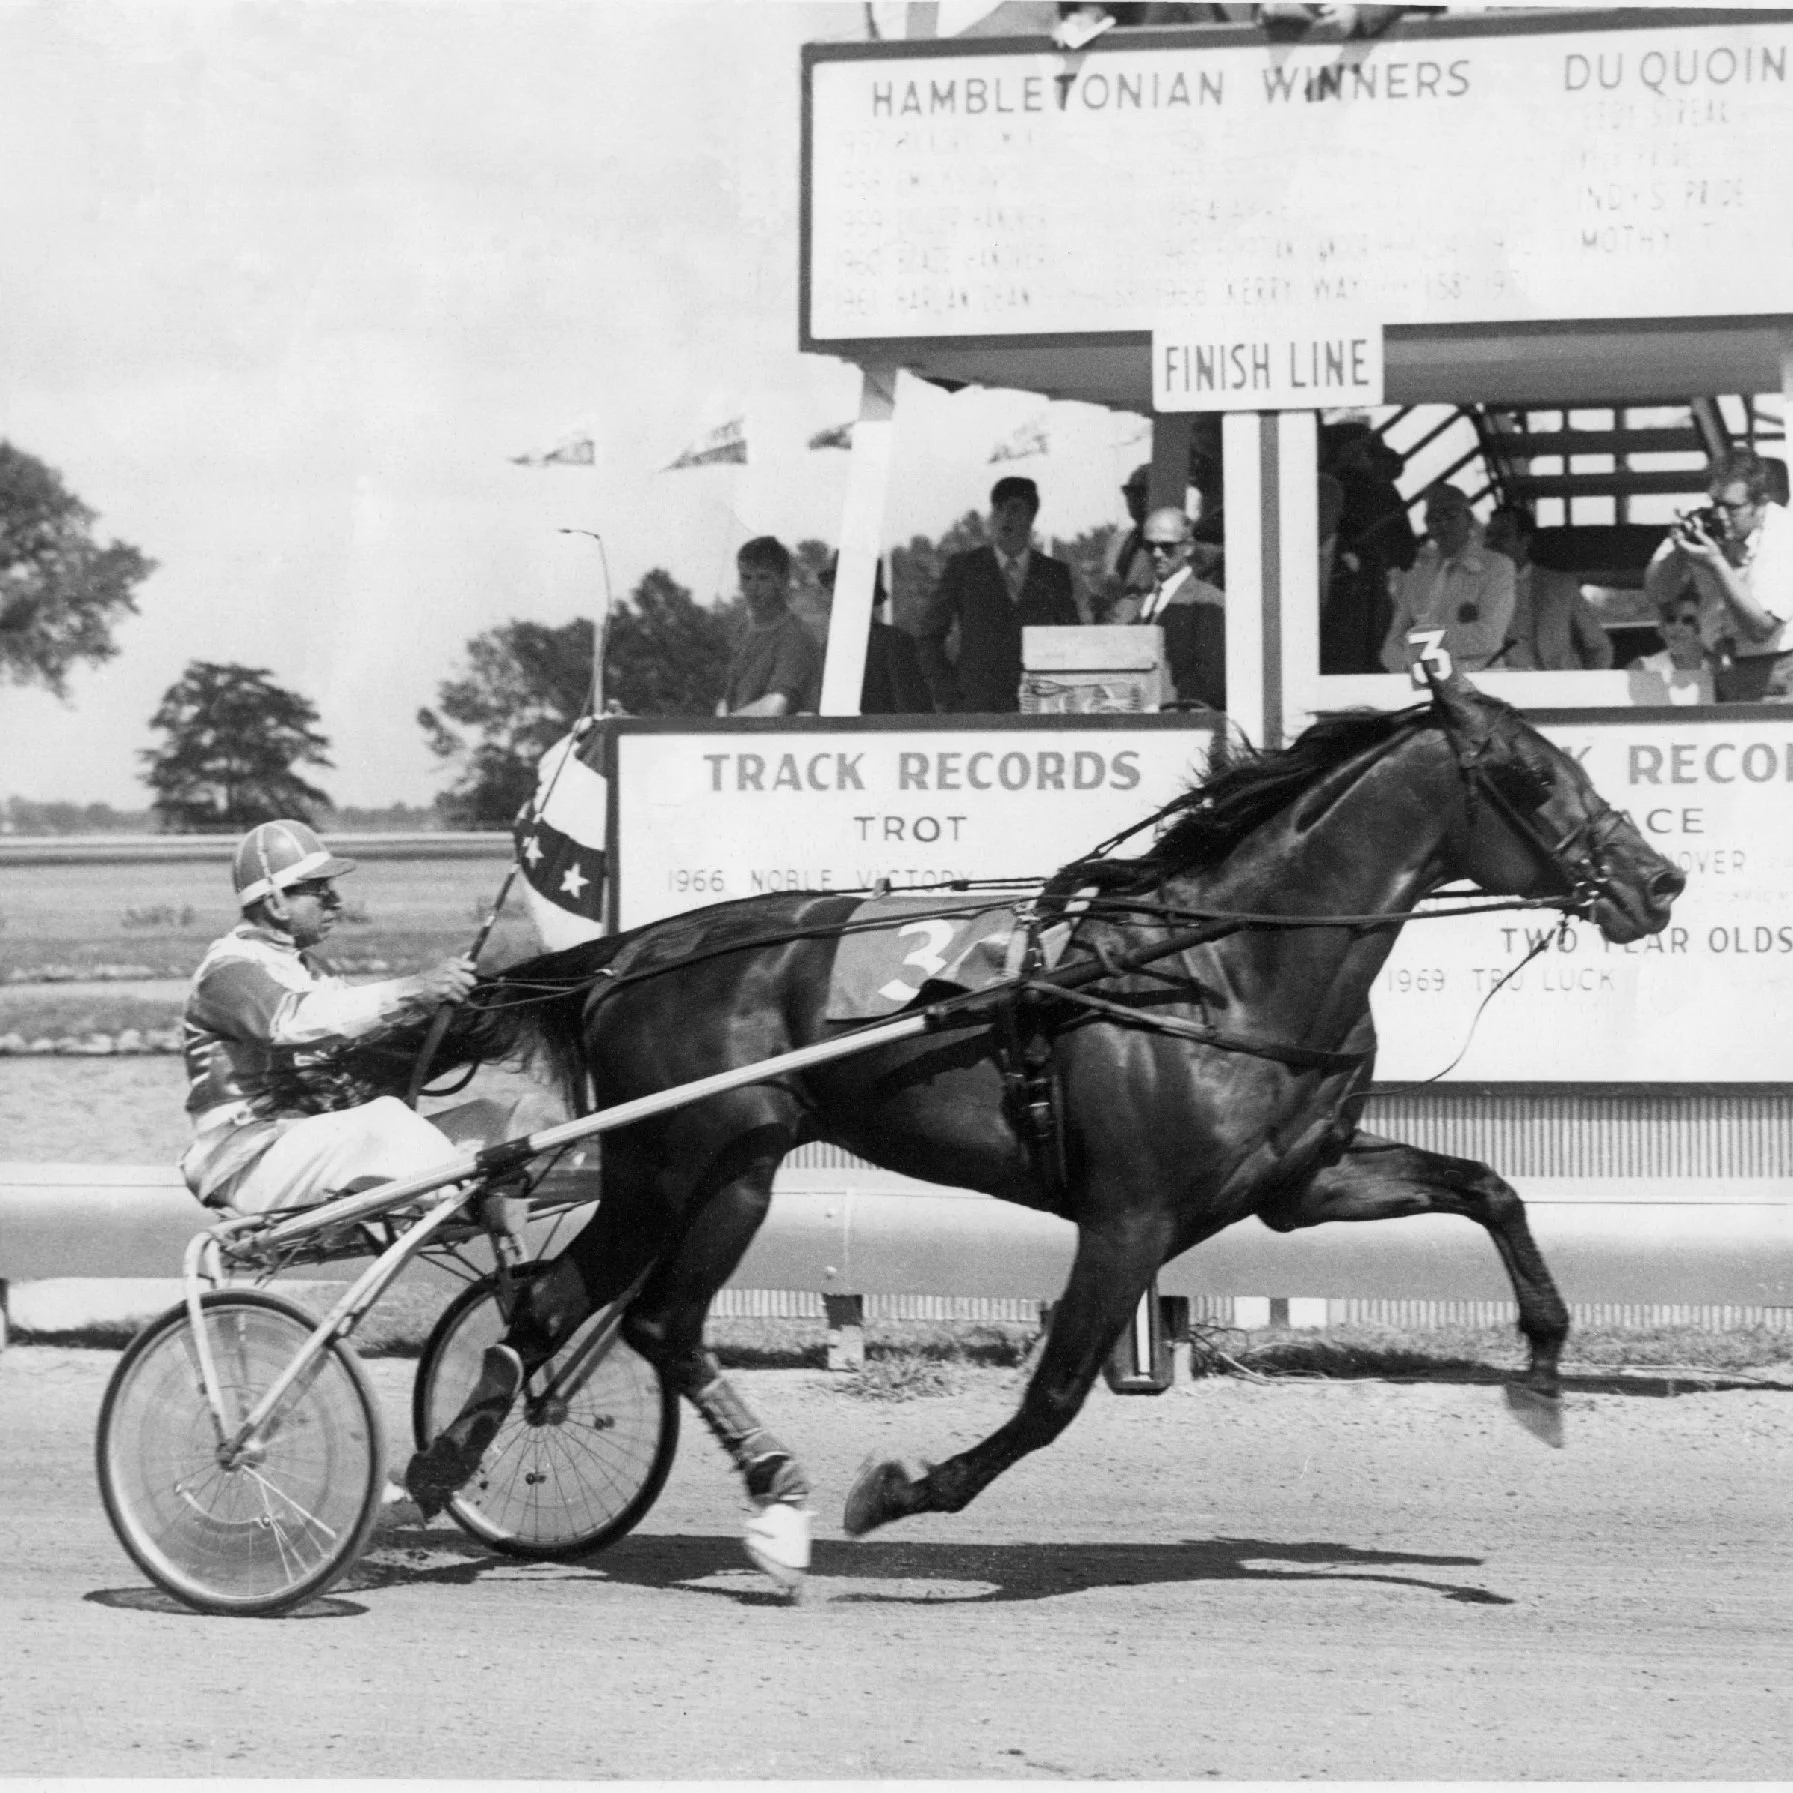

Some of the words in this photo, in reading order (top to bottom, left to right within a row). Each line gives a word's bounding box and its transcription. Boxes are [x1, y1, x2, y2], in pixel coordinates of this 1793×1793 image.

[871, 70, 1224, 118] HAMBLETONIAN
[1262, 58, 1472, 104] WINNERS
[1564, 53, 1624, 92] DU
[1639, 45, 1788, 97] QUOIN
[1166, 342, 1271, 393] FINISH
[1290, 338, 1370, 388] LINE
[1407, 629, 1453, 684] 3
[703, 752, 867, 792] TRACK
[899, 750, 1142, 792] RECORDS
[1628, 742, 1793, 785] RECO
[853, 816, 968, 843] TROT
[1646, 807, 1705, 834] CE
[668, 868, 726, 893] 1966
[751, 868, 834, 893] NOBLE
[877, 919, 955, 1002] 3
[1500, 927, 1578, 954] TWO
[1602, 926, 1690, 954] AR
[1709, 925, 1793, 954] OLDS
[1542, 967, 1617, 992] LUCK
